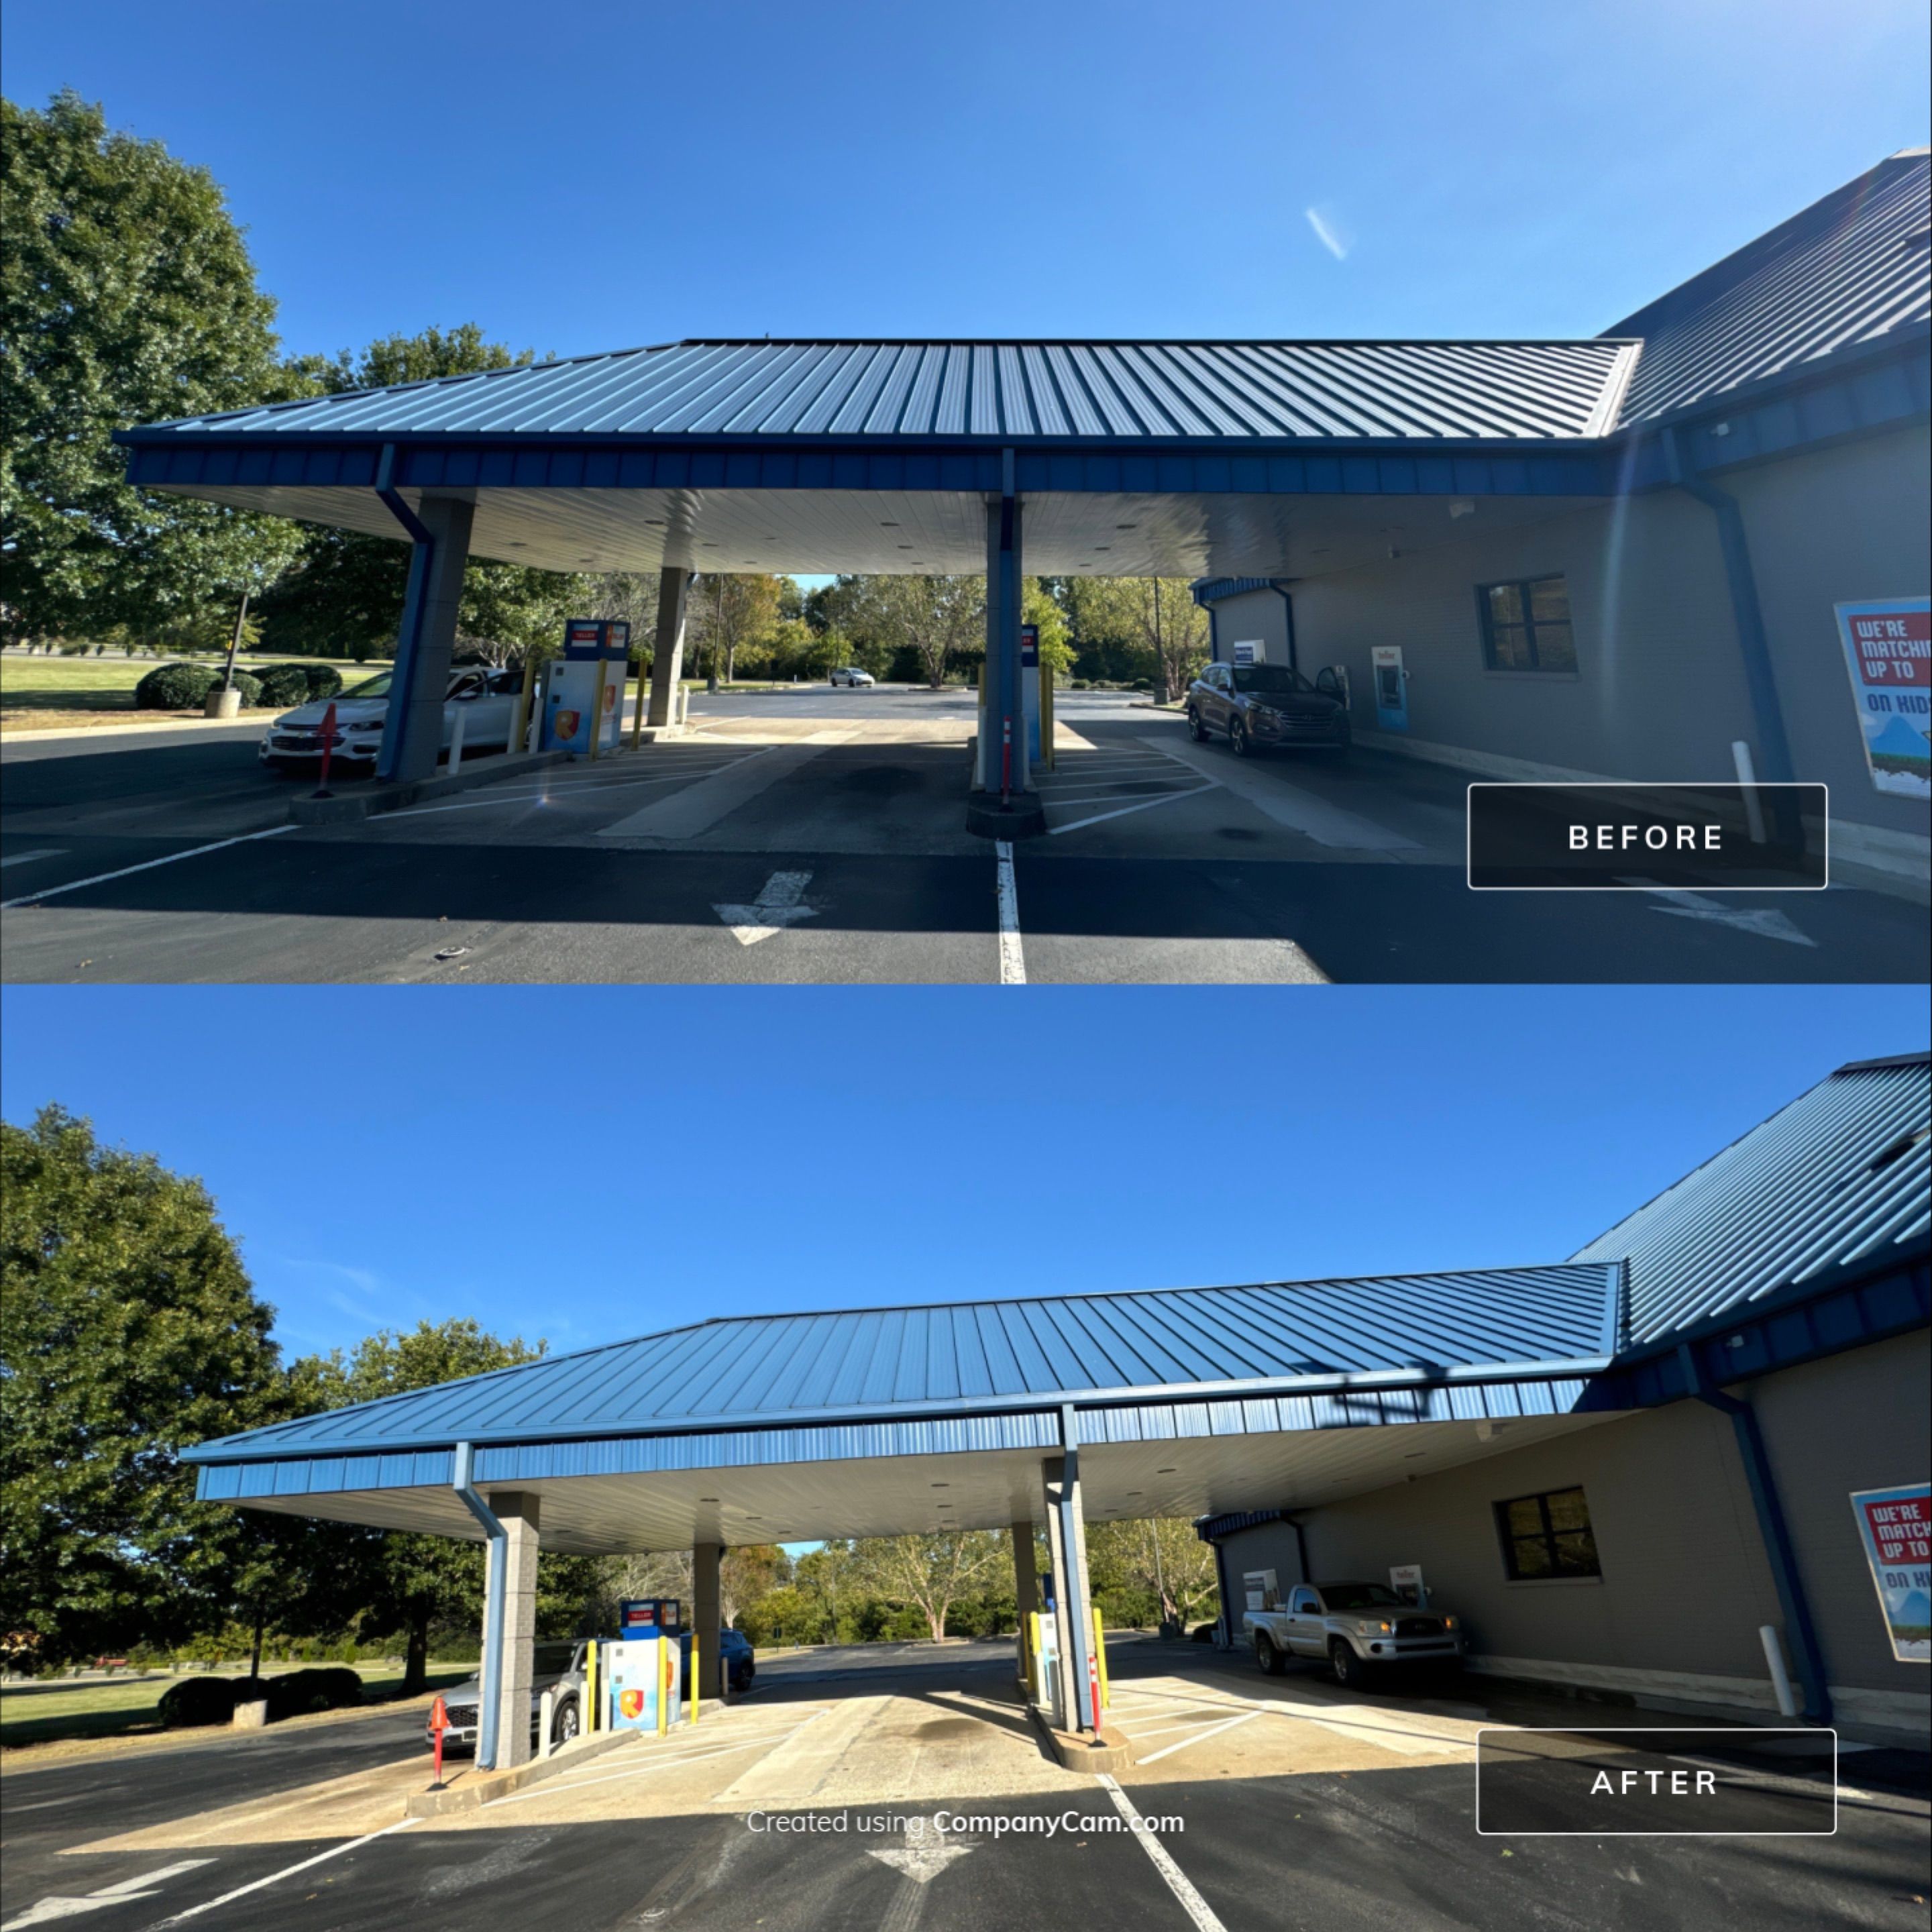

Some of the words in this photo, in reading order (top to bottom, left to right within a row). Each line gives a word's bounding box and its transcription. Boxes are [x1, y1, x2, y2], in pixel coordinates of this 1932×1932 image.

[1856, 620, 1909, 637] WE'RE
[1866, 661, 1887, 678] UP
[1892, 661, 1915, 679] TO
[1896, 694, 1930, 714] KID
[1872, 1503, 1923, 1523] WE'RE
[1882, 1542, 1904, 1558] UP
[1907, 1540, 1930, 1557] TO
